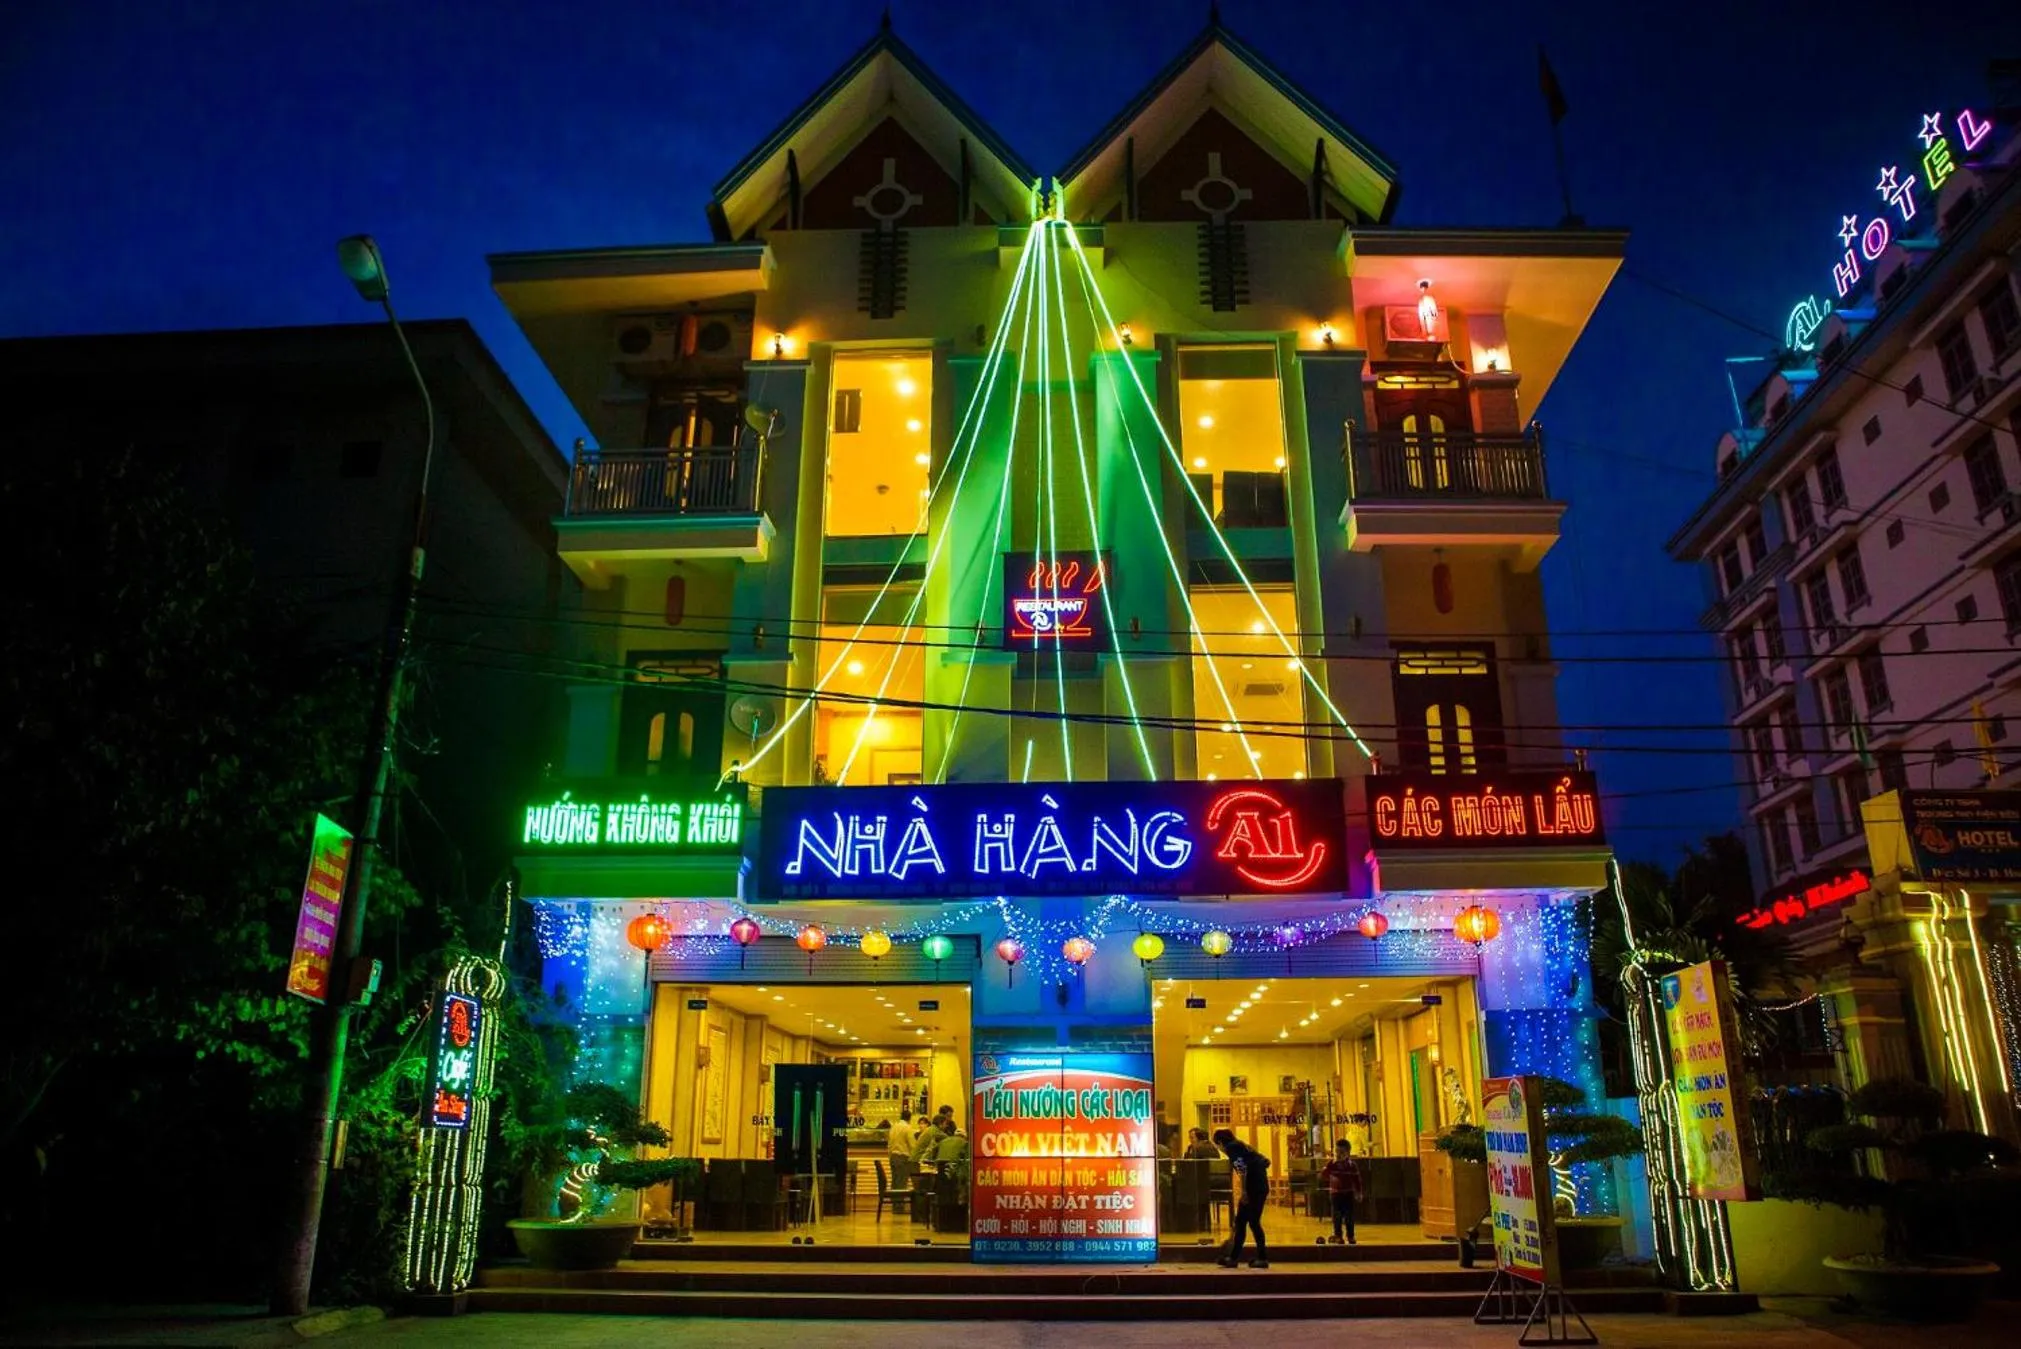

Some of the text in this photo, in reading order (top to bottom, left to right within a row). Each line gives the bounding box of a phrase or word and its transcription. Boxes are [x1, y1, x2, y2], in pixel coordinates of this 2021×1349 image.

[1834, 109, 1992, 298] HOTEL
[523, 791, 599, 845] NƯỚNG
[606, 795, 682, 845] KHÔNG
[1376, 777, 1596, 837] CÁC MÓN LẨU
[785, 794, 1193, 882] NHÀ HÀNG
[1957, 830, 2018, 847] HOTEL
[1018, 1083, 1076, 1120] NƯỚNG
[1081, 1083, 1110, 1122] CÁC
[1114, 1089, 1151, 1125] LOẠI
[981, 1126, 1149, 1163] CƠM VIỆT NAM
[977, 1167, 999, 1186] CÁC
[995, 1190, 1136, 1215] NHẬN ĐẶT TIỆC
[1097, 1219, 1123, 1234] SINH
[1114, 1239, 1134, 1251] 571
[1136, 1239, 1157, 1251] 982
